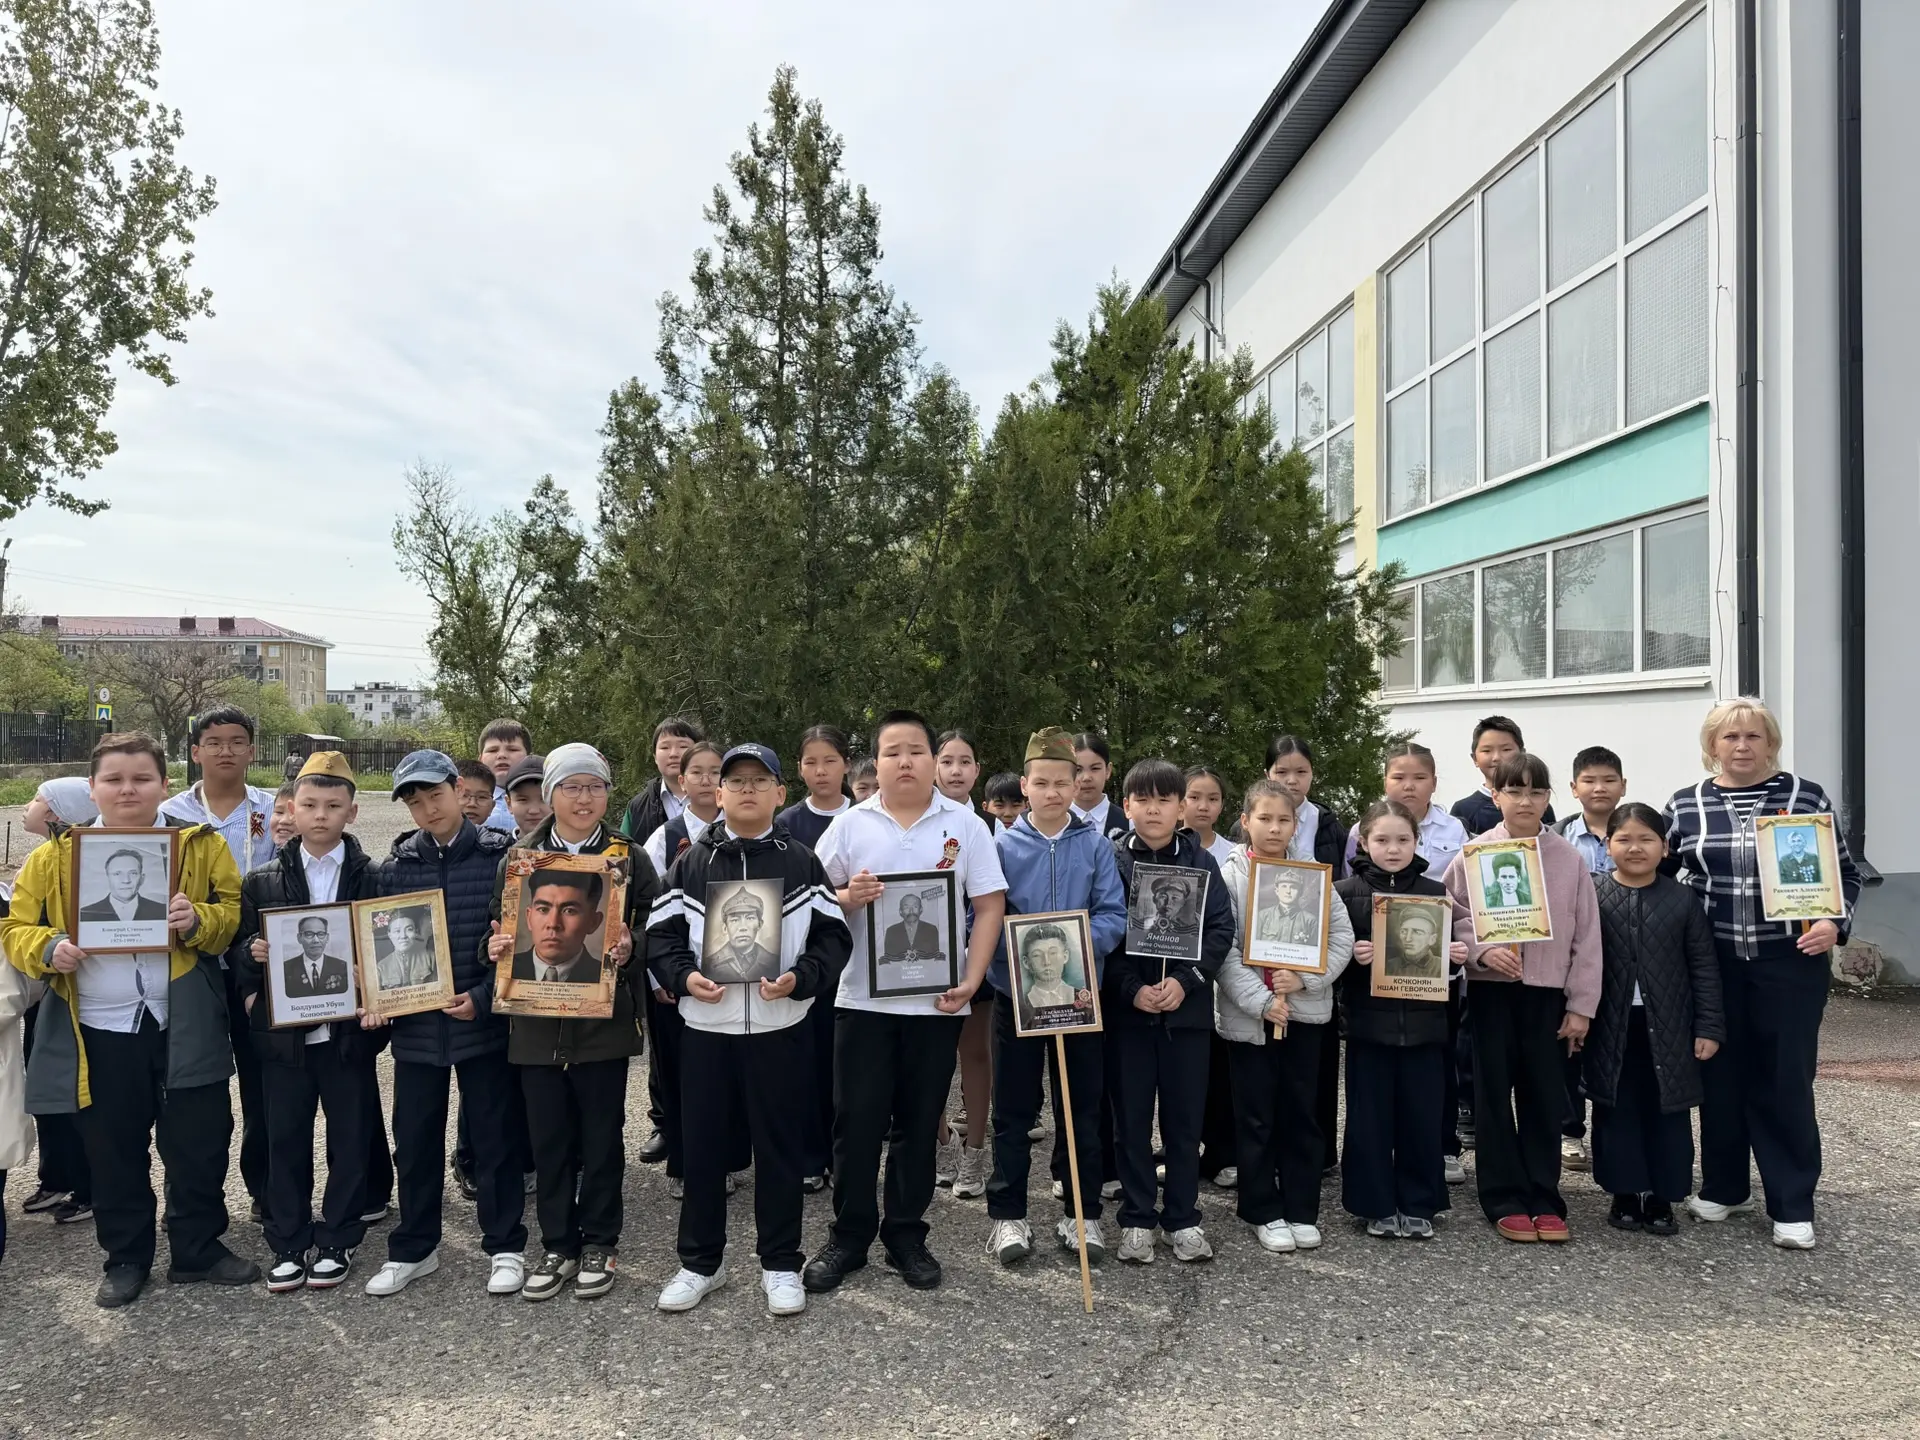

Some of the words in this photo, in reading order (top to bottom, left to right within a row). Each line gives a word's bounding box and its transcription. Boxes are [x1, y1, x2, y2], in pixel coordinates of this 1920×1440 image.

[102, 691, 107, 699] 5
[1146, 932, 1180, 943] Яманов
[290, 1003, 325, 1012] Болдунов
[325, 1001, 345, 1009] Убуш
[300, 1010, 337, 1018] Конюевич
